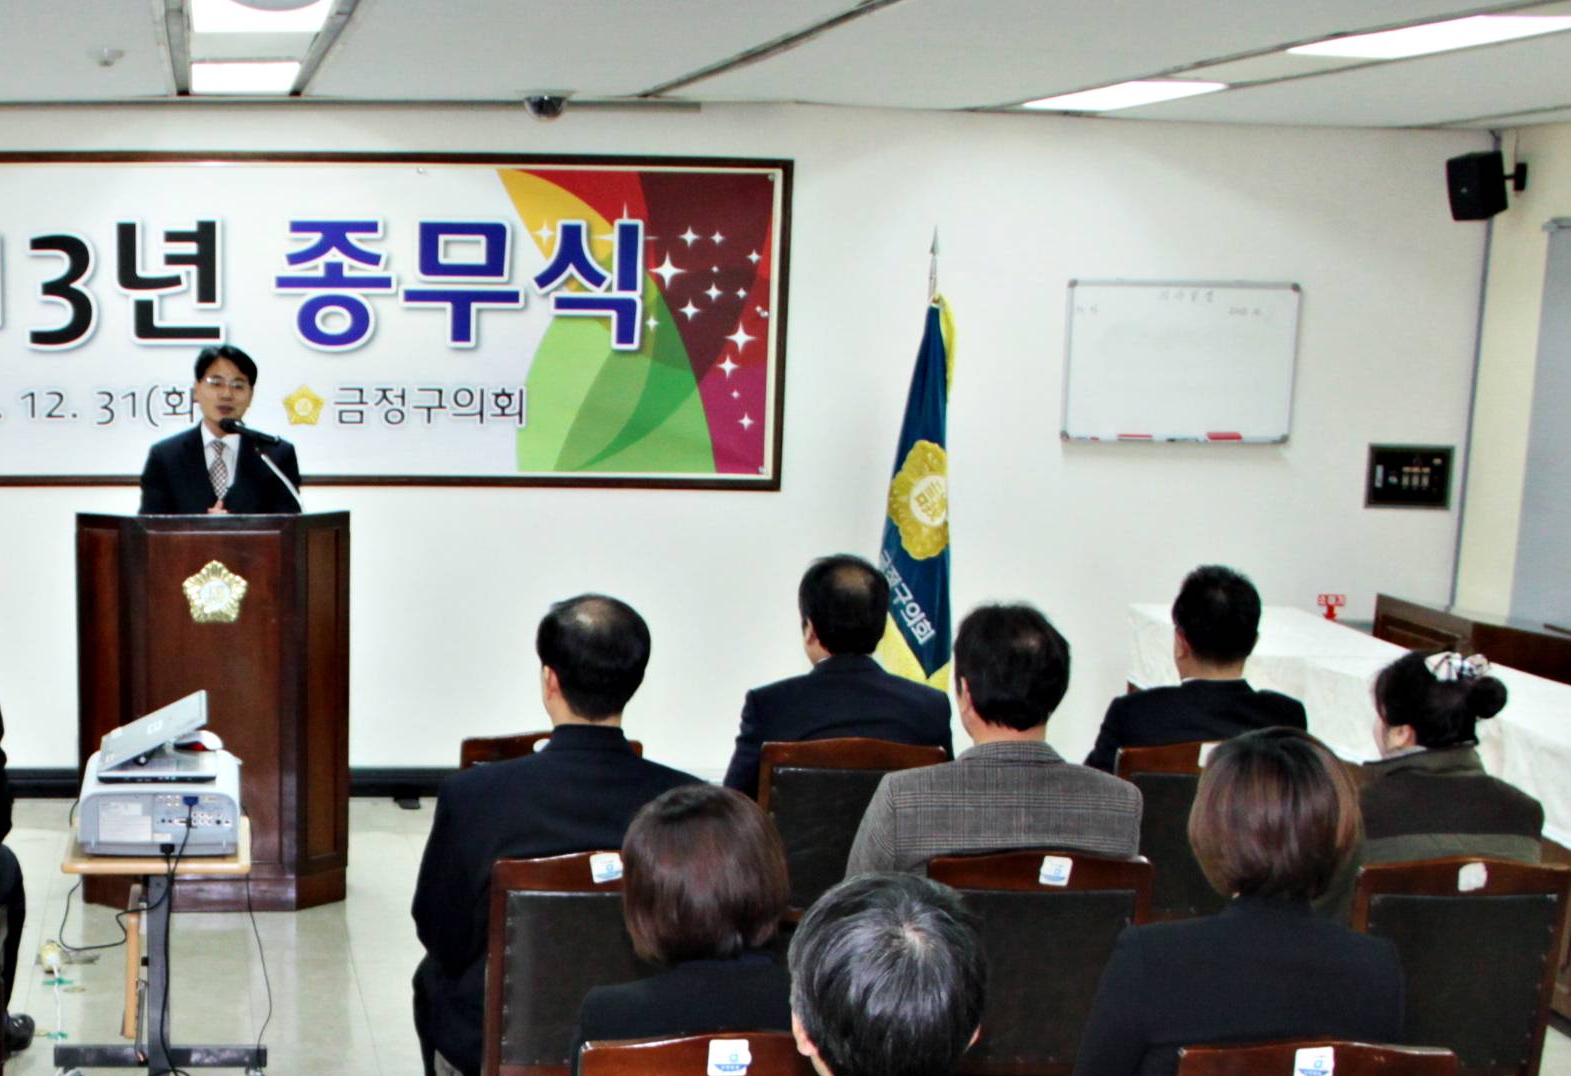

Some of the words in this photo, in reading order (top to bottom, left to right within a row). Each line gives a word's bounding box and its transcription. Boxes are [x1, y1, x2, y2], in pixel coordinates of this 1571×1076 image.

[274, 219, 642, 347] 종무식
[20, 391, 79, 421] 12.
[96, 385, 197, 428] 31(화
[333, 385, 525, 426] 금정구의회
